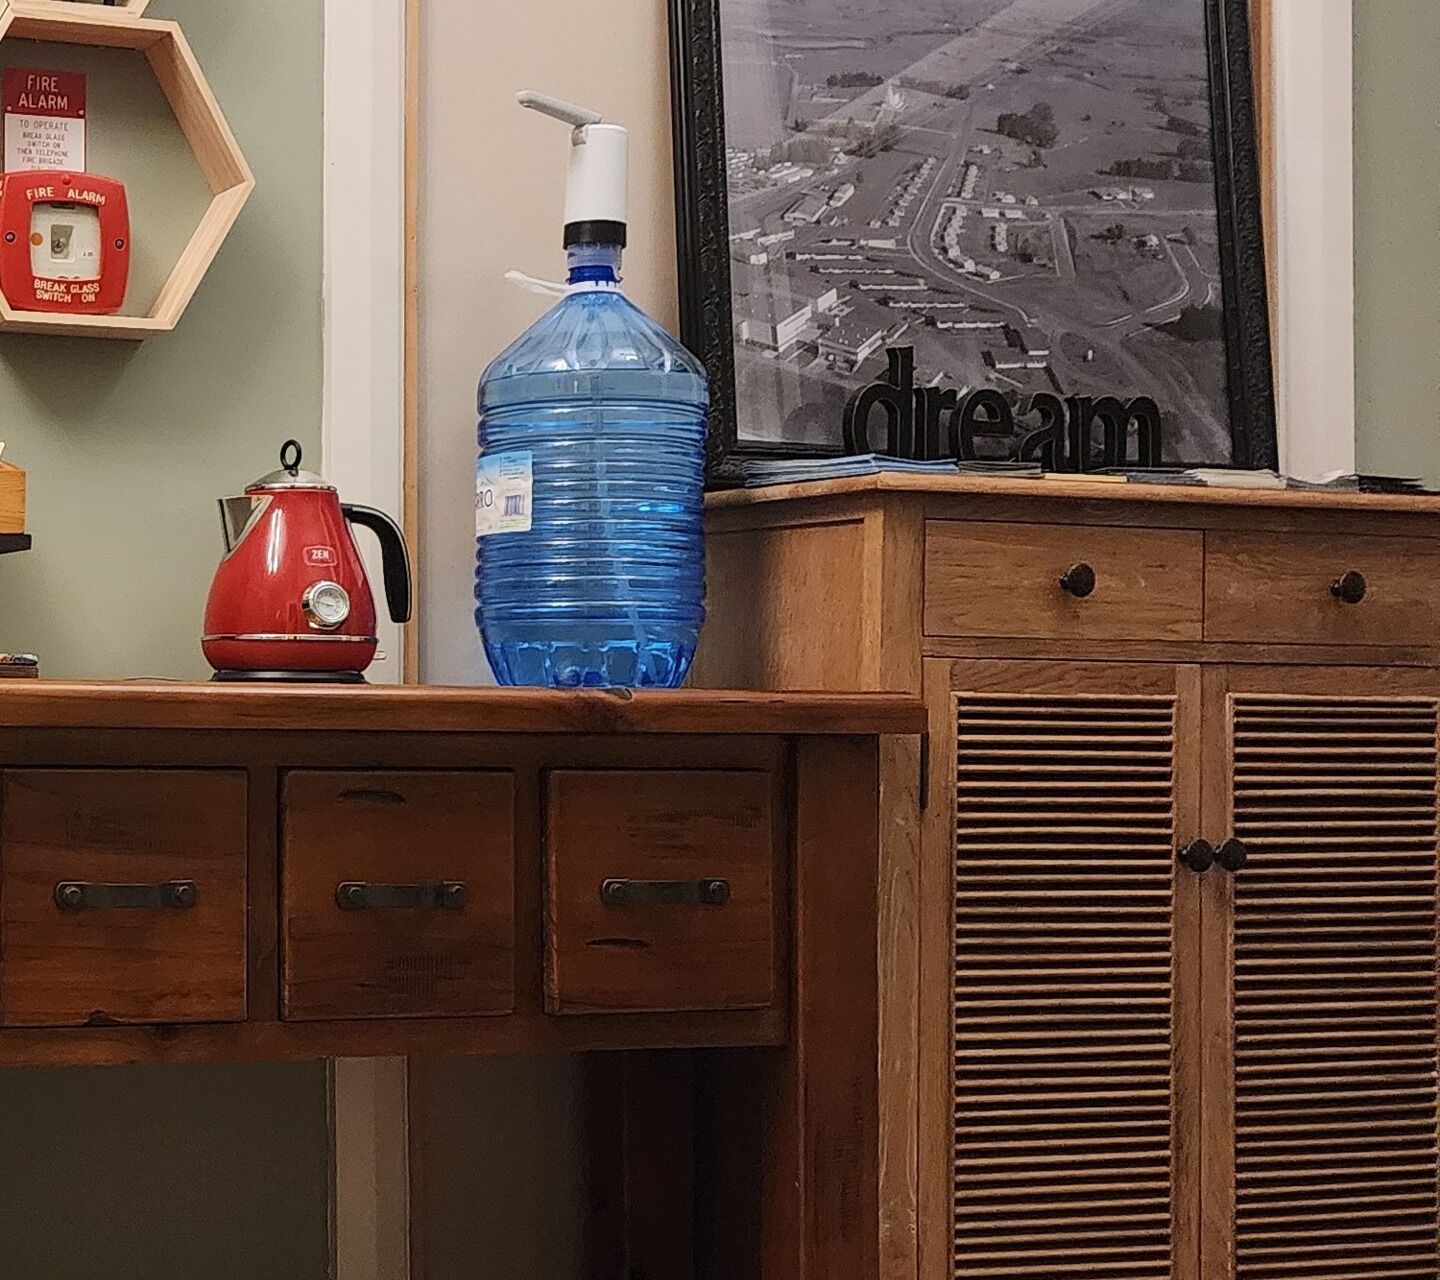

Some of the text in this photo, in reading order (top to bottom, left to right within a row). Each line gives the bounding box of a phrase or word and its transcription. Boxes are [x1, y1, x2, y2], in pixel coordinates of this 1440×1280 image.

[27, 75, 59, 92] FIRE
[18, 93, 68, 110] ALARM
[20, 120, 69, 131] TO OPERATE
[22, 131, 65, 141] BREAK GLASS
[26, 186, 106, 205] FIRE ALARM
[33, 279, 100, 294] BREAK GLASS
[35, 290, 96, 303] SWITCH ON
[843, 345, 1161, 470] dream
[311, 549, 330, 561] ZEN
